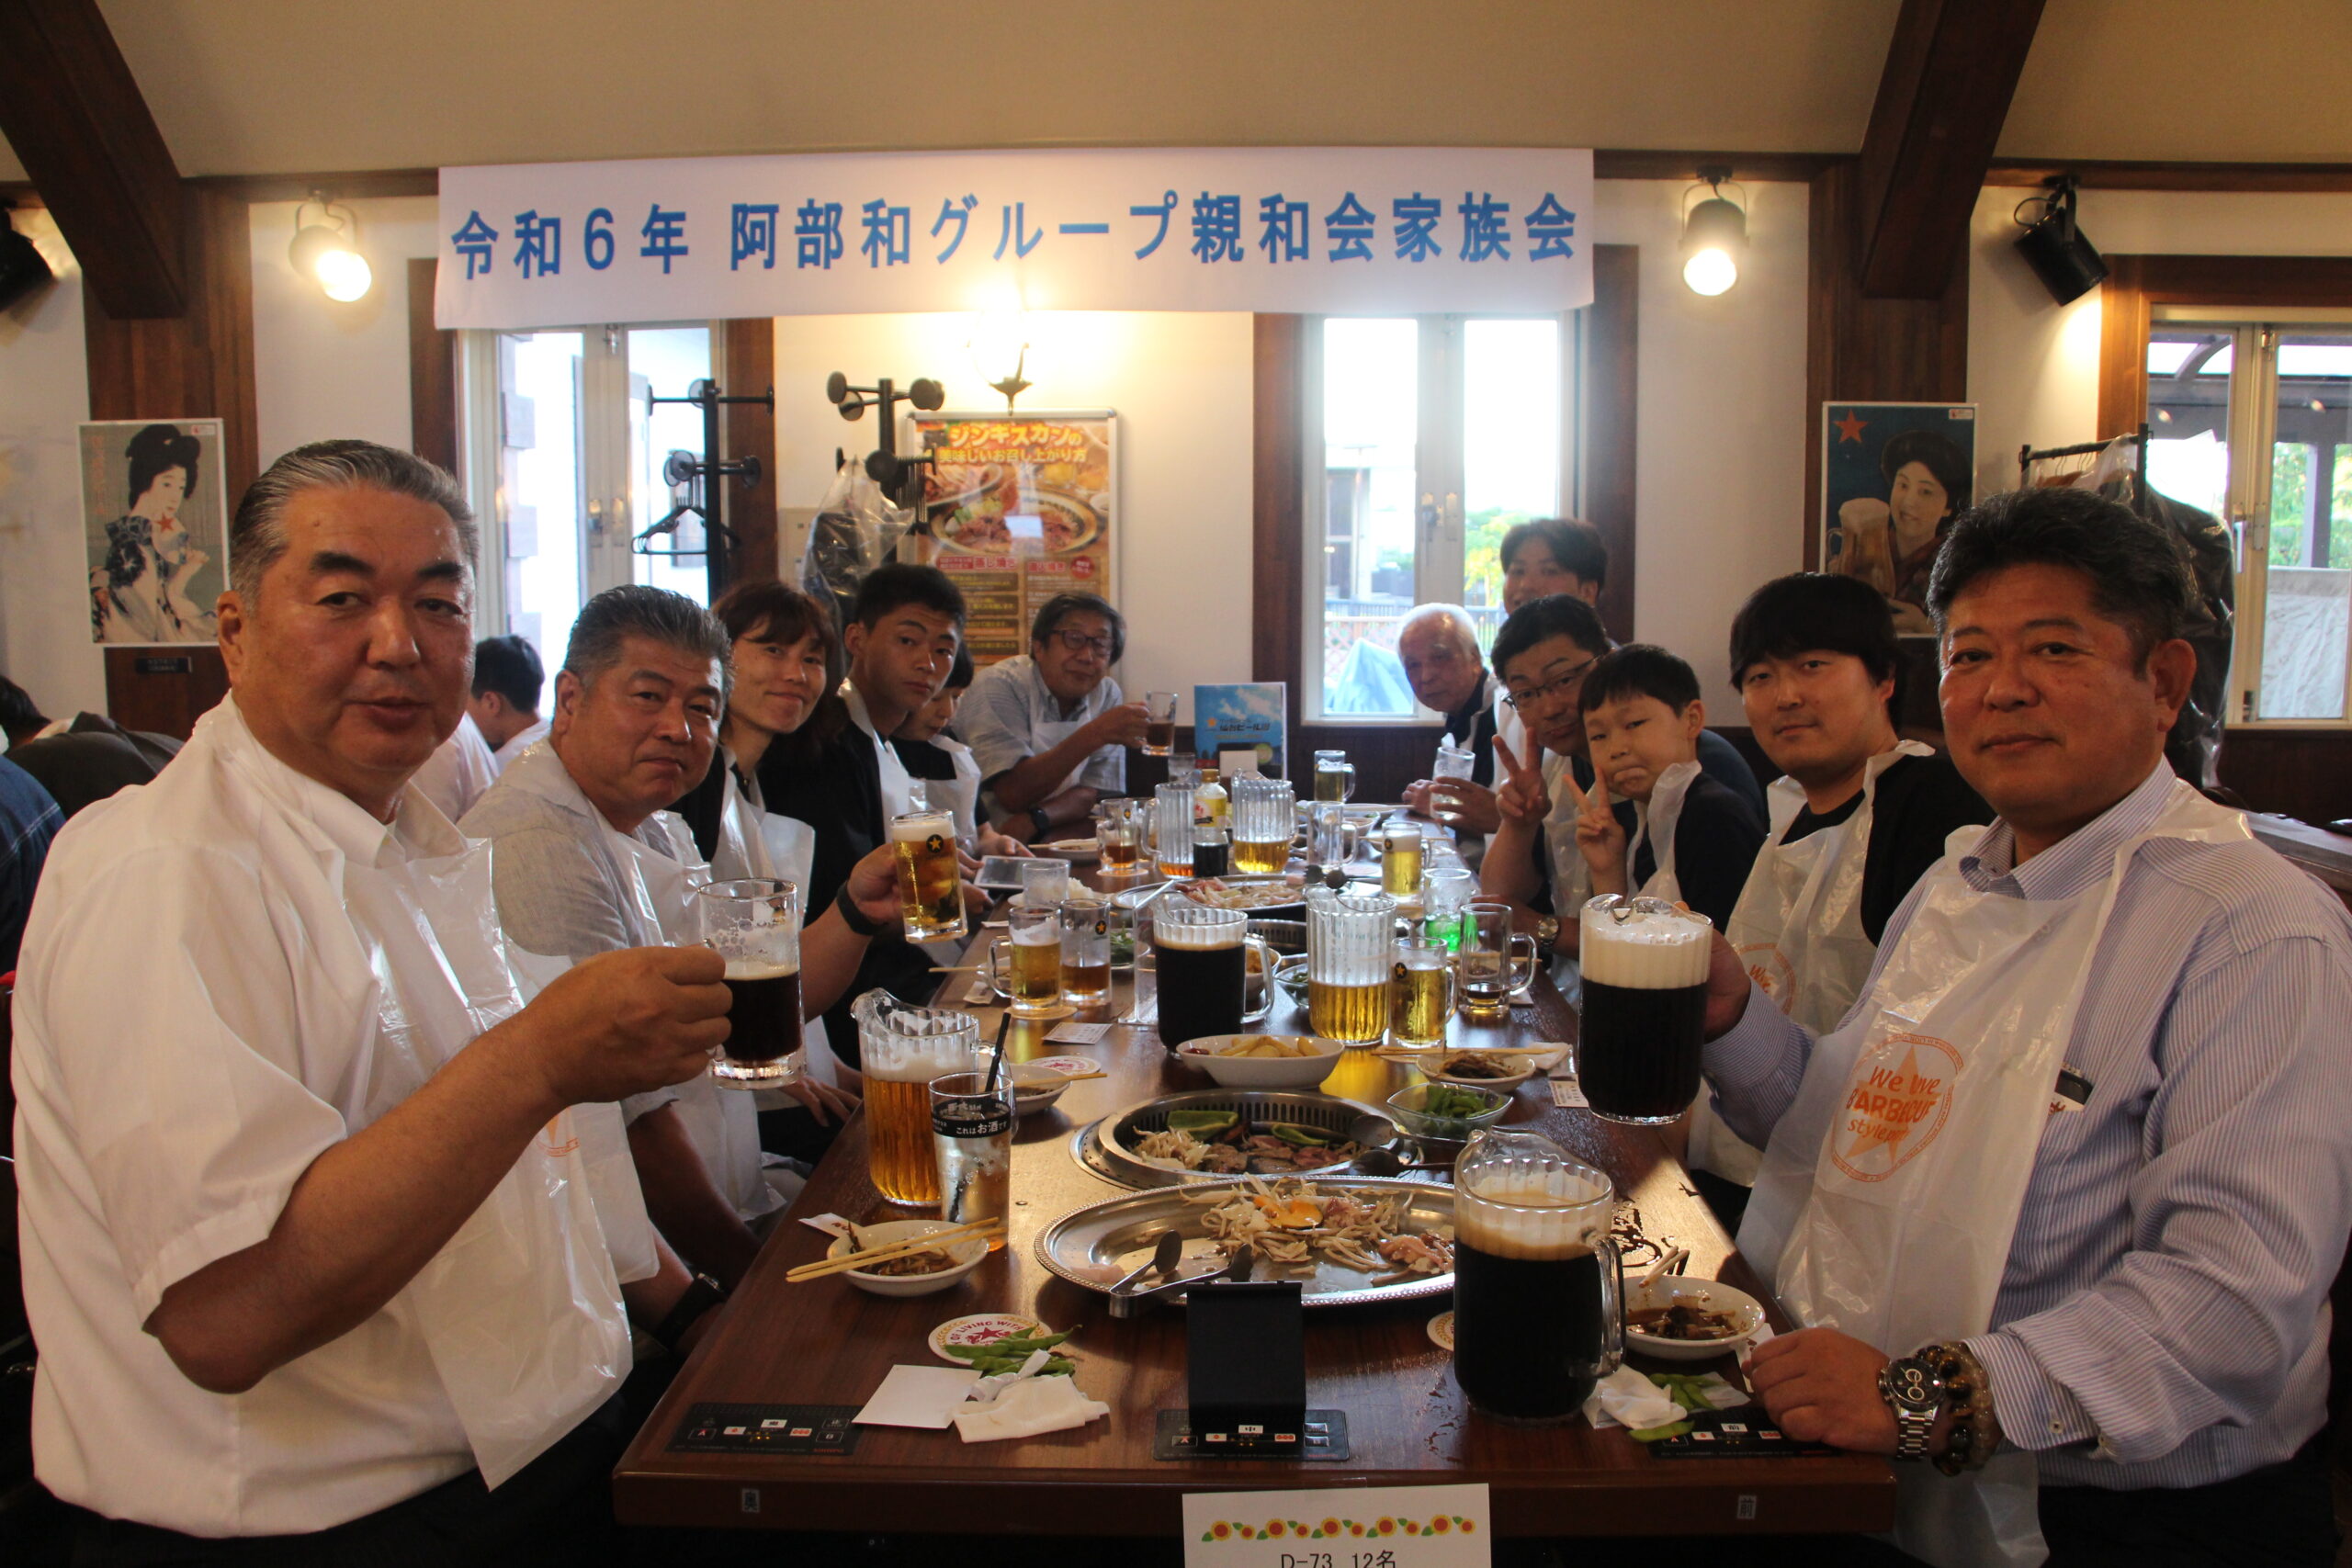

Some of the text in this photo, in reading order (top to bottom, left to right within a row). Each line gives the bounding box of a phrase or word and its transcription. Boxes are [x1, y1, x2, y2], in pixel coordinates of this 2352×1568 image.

[451, 189, 1577, 279] 令和6年 阿部和グループ親和会家族会
[949, 423, 1082, 447] ジンギスカンの
[938, 447, 1088, 463] 美味しいお召し上がり方
[1869, 1066, 1904, 1092] We
[956, 1121, 1007, 1134] これはお酒です
[1848, 1118, 1886, 1139] style
[959, 1321, 993, 1333] LIVING
[1281, 1550, 1396, 1568] D-73 12名
